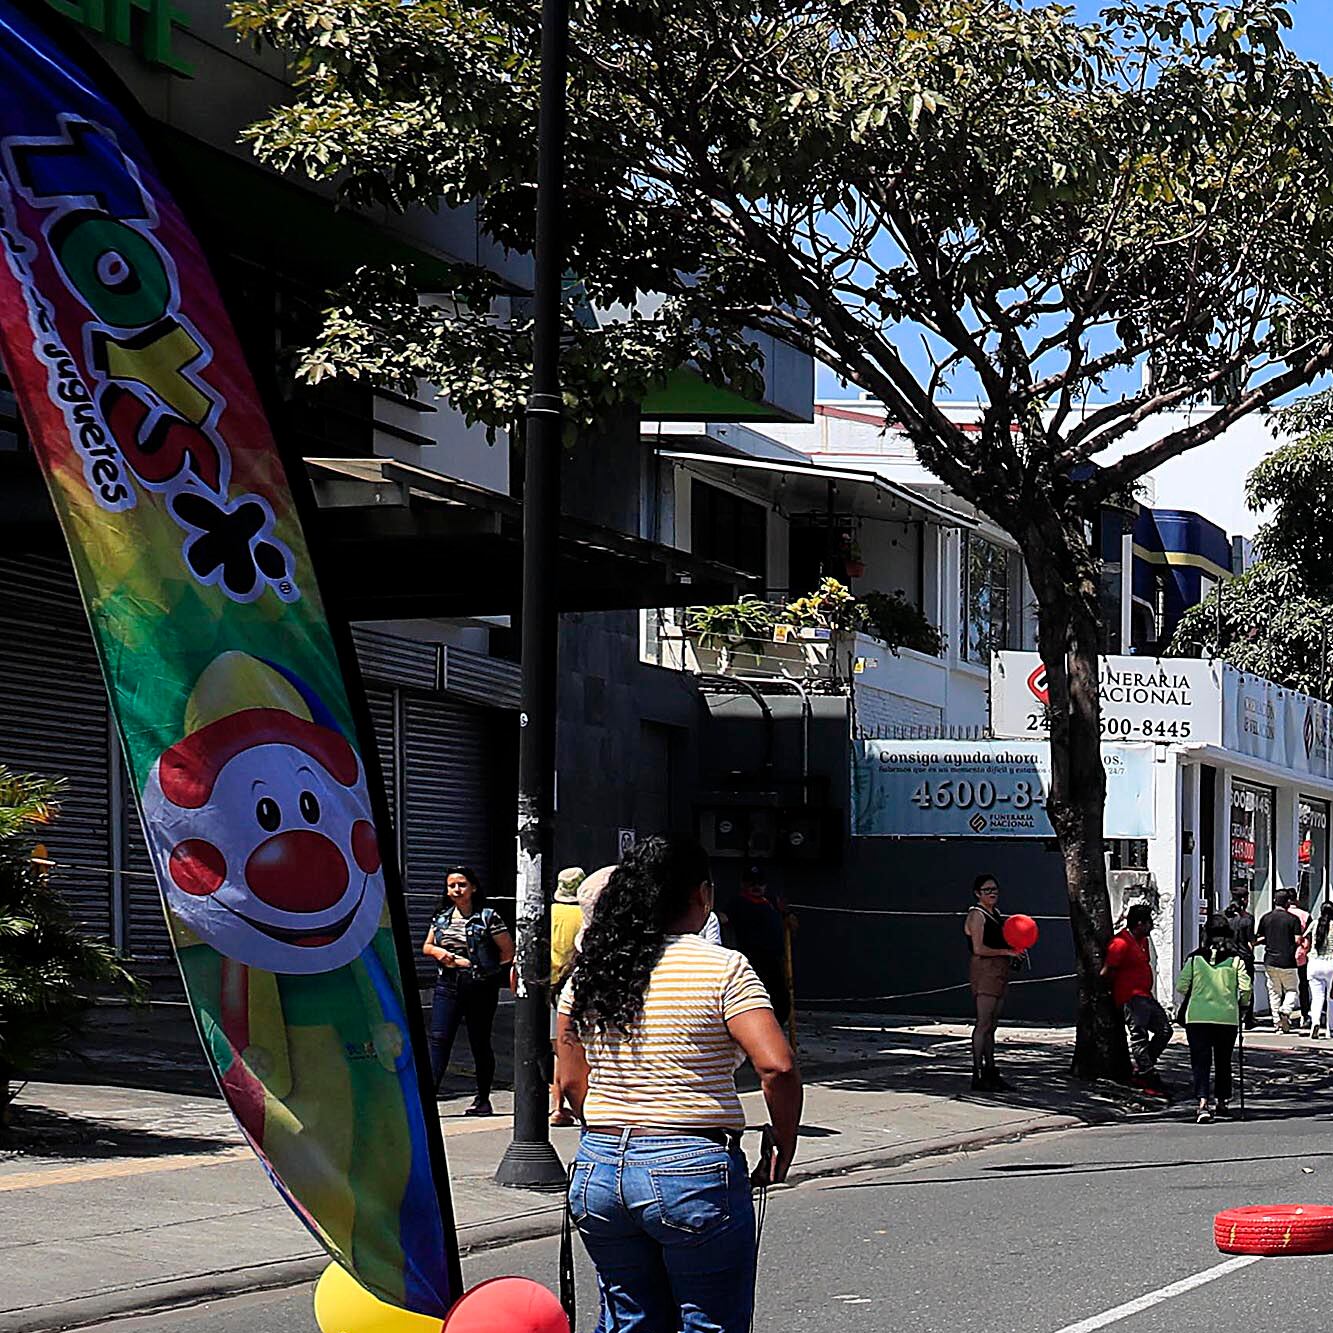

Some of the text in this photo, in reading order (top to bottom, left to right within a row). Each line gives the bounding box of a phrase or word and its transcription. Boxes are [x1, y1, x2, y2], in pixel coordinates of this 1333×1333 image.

[12, 116, 225, 498] TOYS
[1098, 671, 1191, 689] UNERARIA
[1099, 688, 1192, 706] ACIONAL
[880, 750, 939, 767] Consiga
[943, 751, 991, 769] ayuda
[912, 779, 1047, 811] 4600-84
